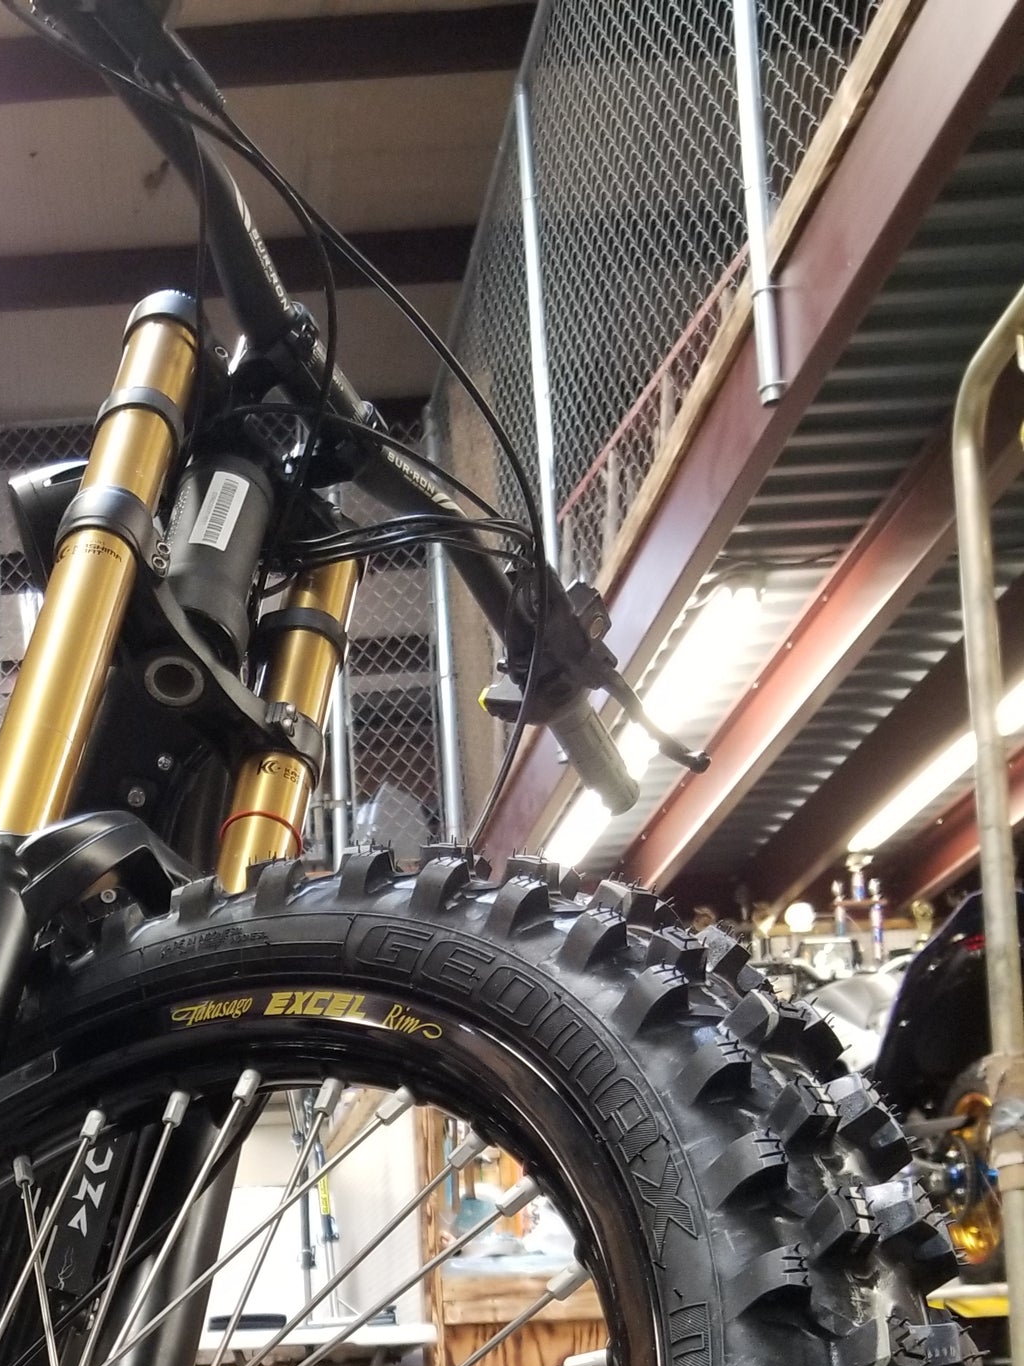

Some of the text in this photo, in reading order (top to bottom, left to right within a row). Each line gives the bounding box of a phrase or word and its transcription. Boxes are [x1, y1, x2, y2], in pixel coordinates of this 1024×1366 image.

[171, 991, 442, 1039] Takasago EXCEL Rim
[351, 920, 699, 1261] GEOMAX
